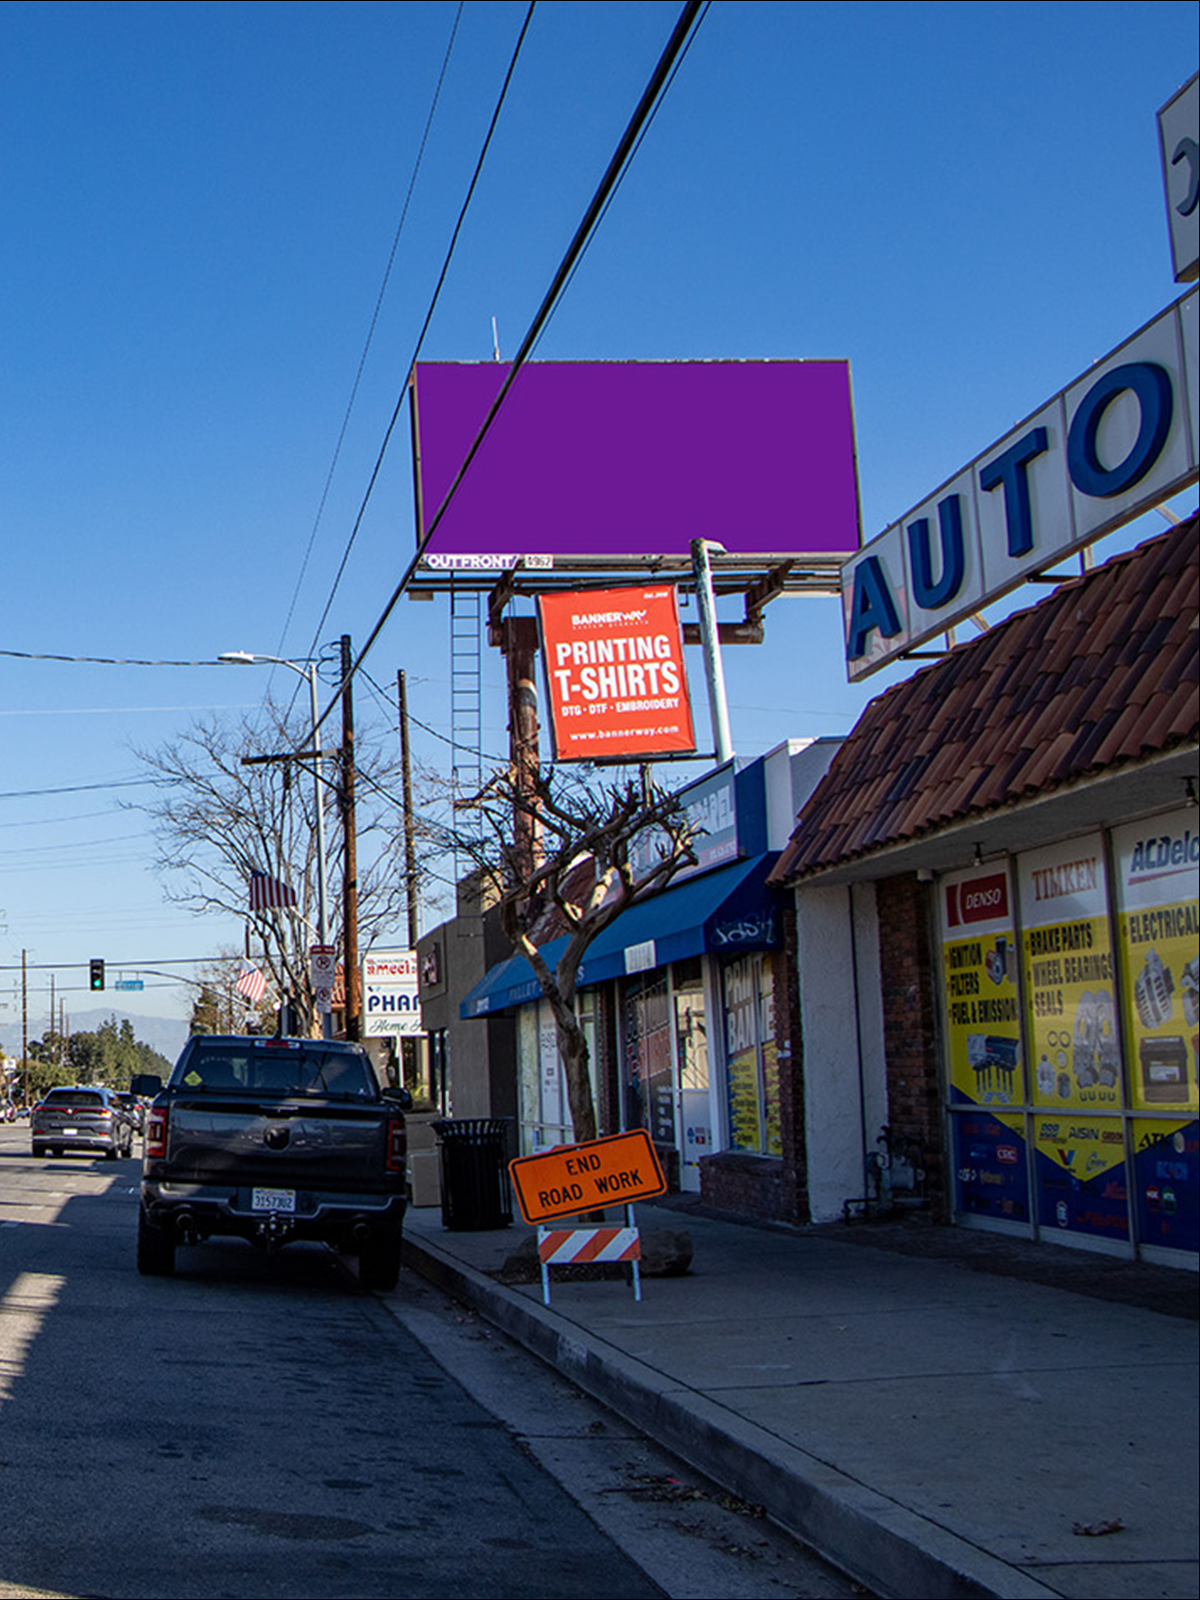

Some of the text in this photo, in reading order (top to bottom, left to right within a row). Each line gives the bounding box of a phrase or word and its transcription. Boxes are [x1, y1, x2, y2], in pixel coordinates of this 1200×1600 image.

[847, 361, 1175, 662] AUTO
[555, 635, 672, 666] PRINTING
[554, 661, 680, 701] T-SHIRTS
[561, 698, 680, 717] DTG DTF EMBROIDERY
[570, 726, 679, 741] www.bannerway.com
[1031, 857, 1097, 901] TIMKEN
[965, 888, 1002, 910] DENSO
[1129, 905, 1199, 944] ELECTRICAL
[1030, 923, 1093, 956] BRAKE PARTS
[949, 943, 982, 969] IGNITION
[1032, 952, 1113, 987] WHEEL BEARINGS
[950, 971, 980, 997] FILTERS
[952, 1001, 969, 1025] FUEL
[1034, 990, 1064, 1017] SEALS
[1068, 1126, 1099, 1140] AISIN
[565, 1154, 601, 1176] END
[538, 1169, 643, 1208] ROAD WORK
